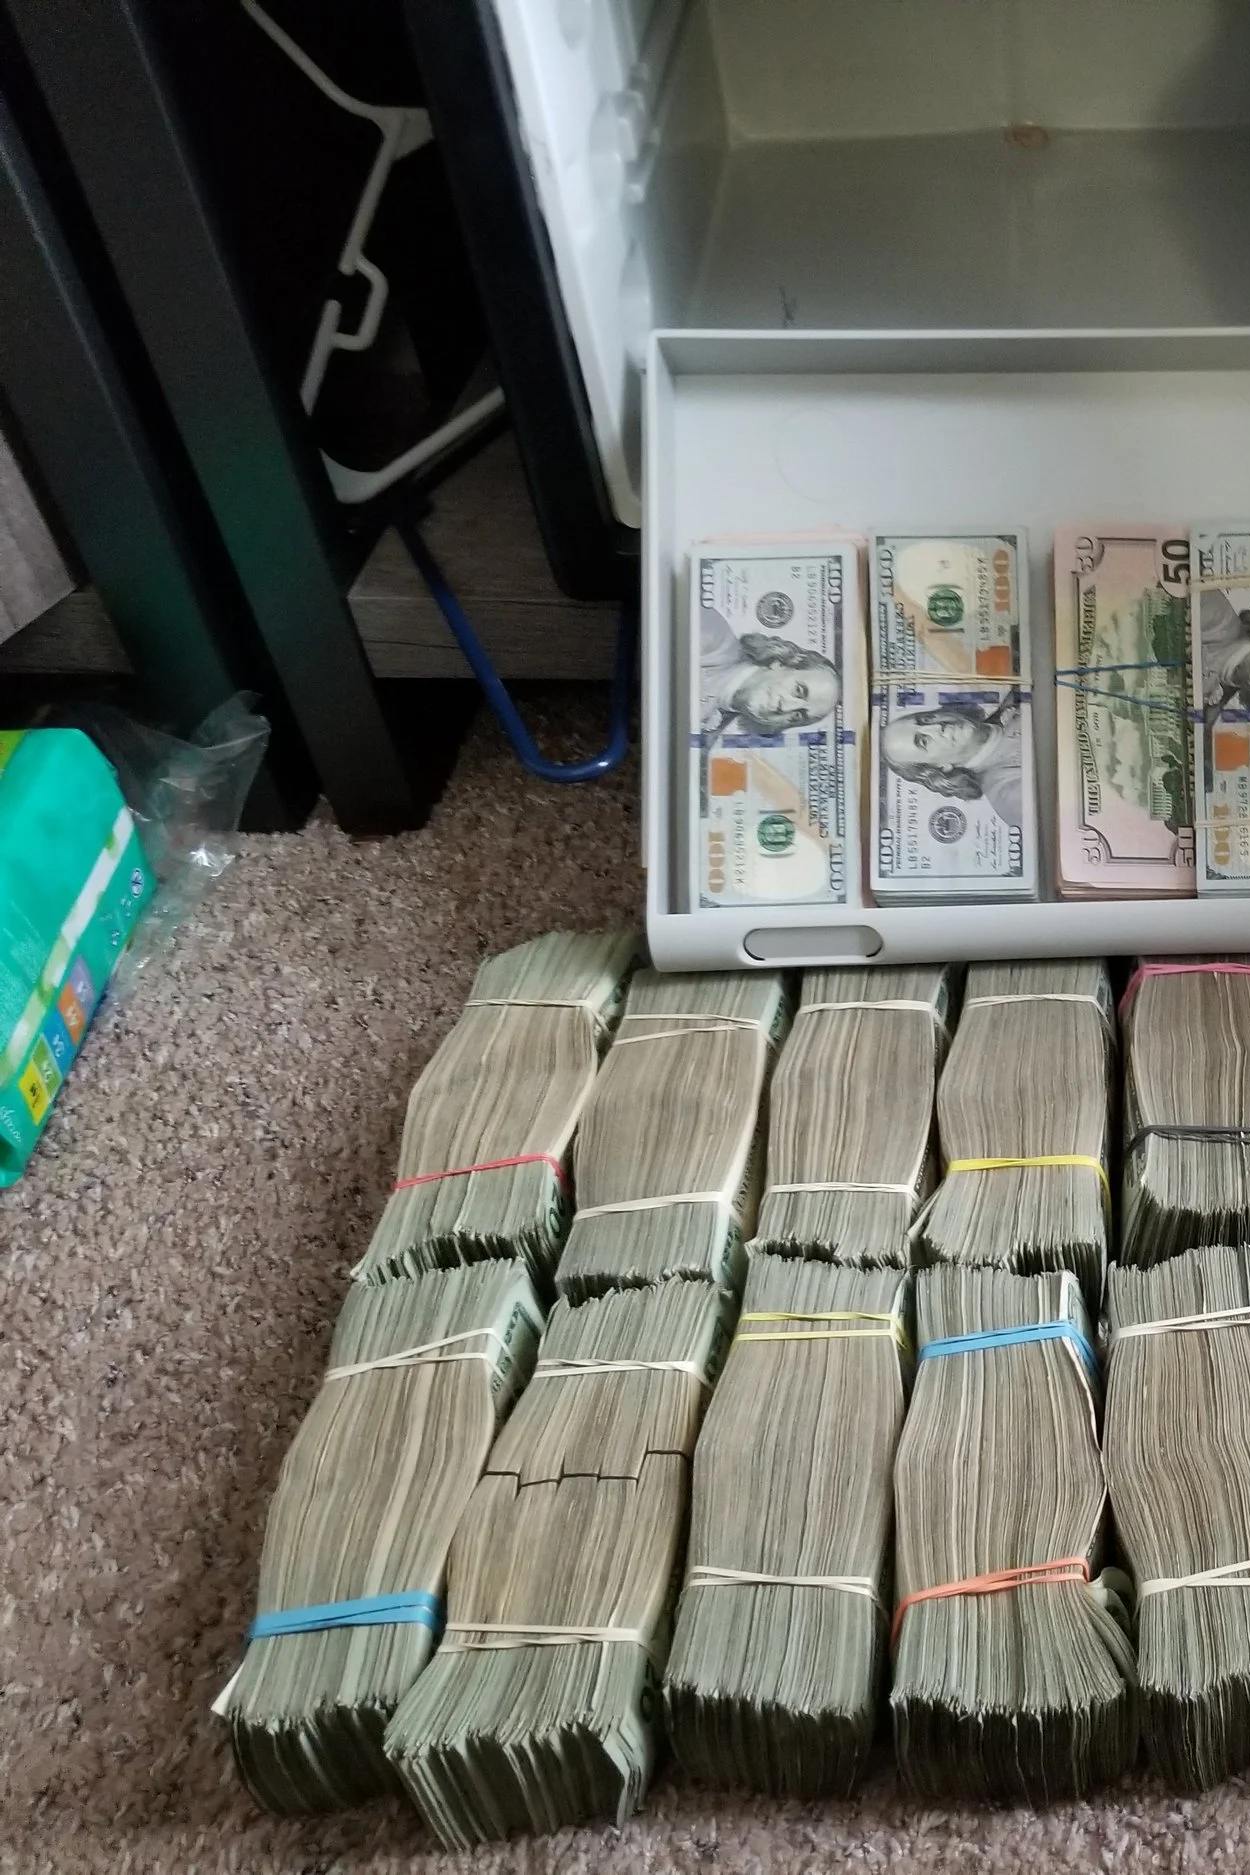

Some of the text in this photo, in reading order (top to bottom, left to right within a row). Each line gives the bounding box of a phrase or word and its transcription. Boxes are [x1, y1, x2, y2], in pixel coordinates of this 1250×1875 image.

[828, 559, 841, 604] 100
[993, 549, 1010, 612] 100
[1161, 540, 1190, 584] 50
[708, 831, 725, 894] 100
[880, 828, 894, 873] 100
[1008, 825, 1022, 869] 100
[1175, 827, 1194, 868] 50
